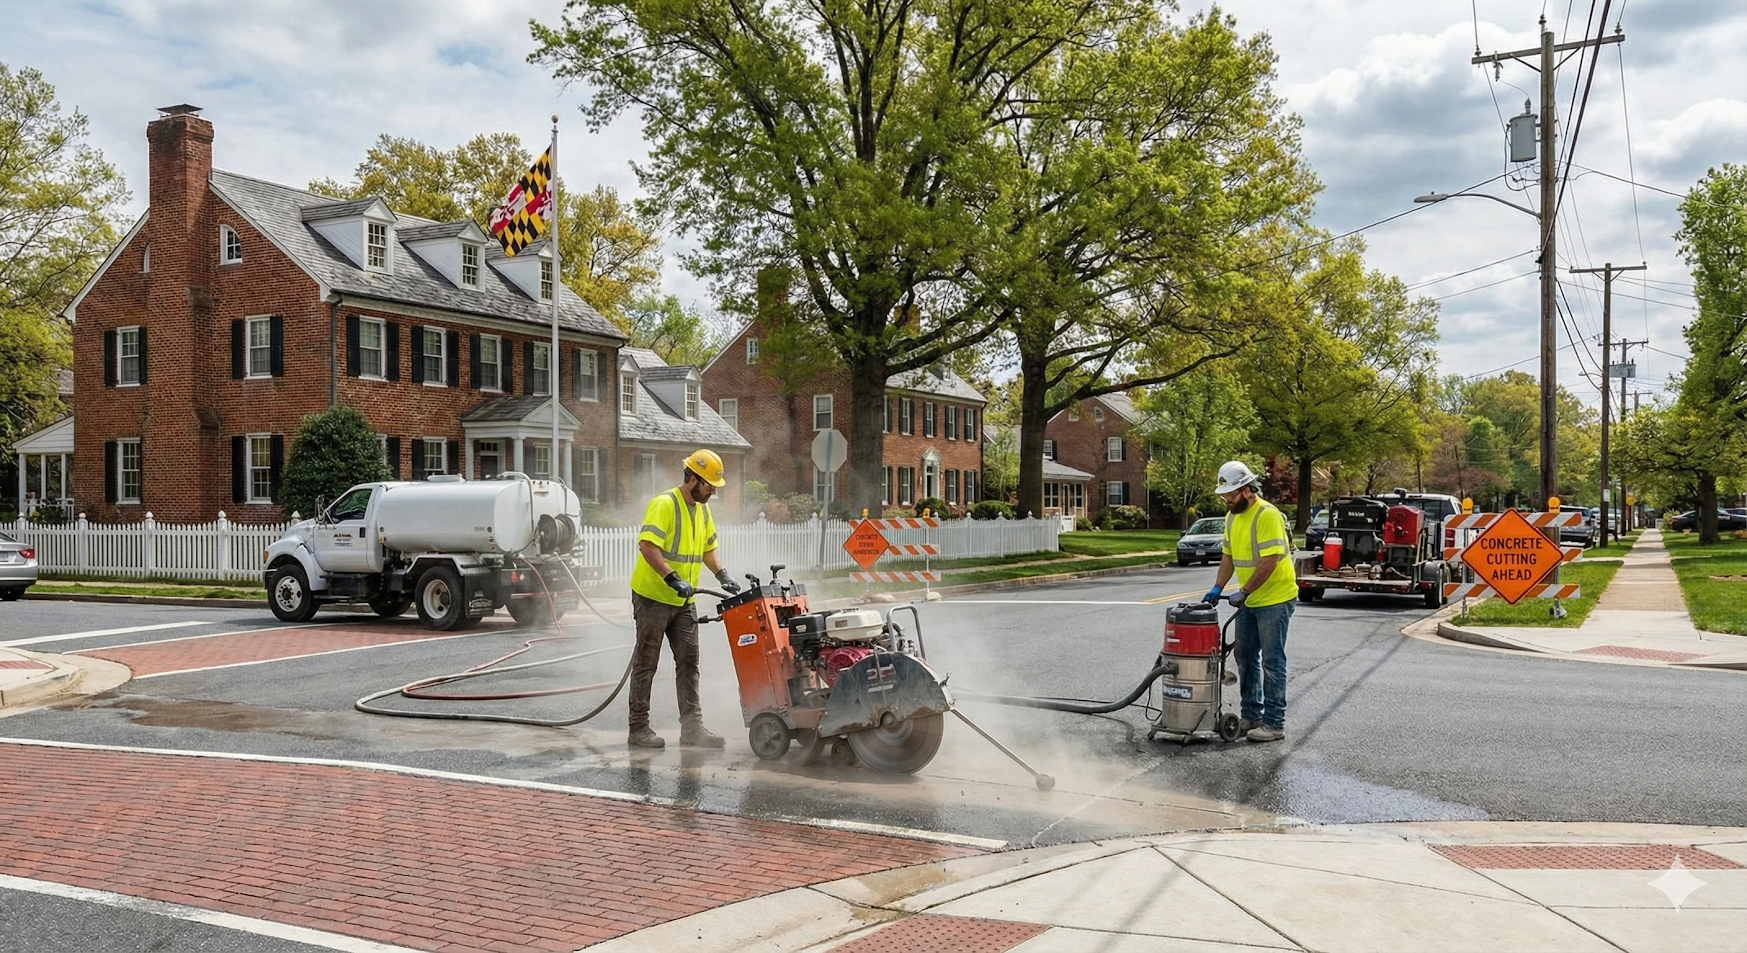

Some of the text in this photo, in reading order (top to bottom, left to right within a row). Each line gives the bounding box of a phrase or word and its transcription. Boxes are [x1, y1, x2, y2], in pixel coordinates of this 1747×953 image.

[1480, 537, 1543, 549] CONCRETE
[1486, 553, 1537, 565] CUTTING
[1491, 569, 1532, 580] AHEAD
